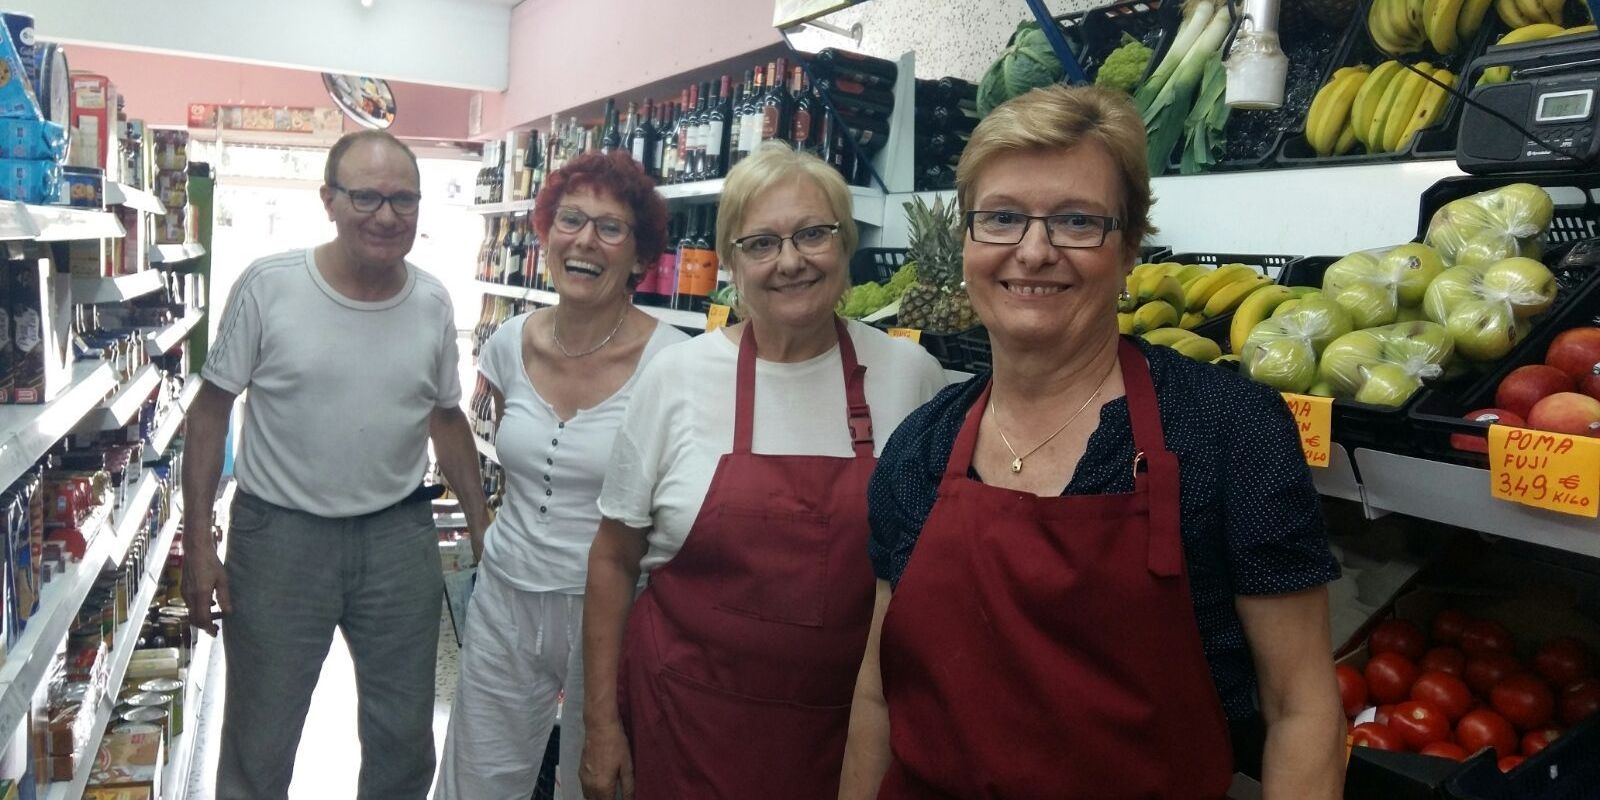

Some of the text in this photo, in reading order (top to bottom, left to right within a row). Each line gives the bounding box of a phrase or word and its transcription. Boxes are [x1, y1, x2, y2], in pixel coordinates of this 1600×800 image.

[1306, 436, 1320, 447] €
[1504, 430, 1574, 454] POMA
[1504, 454, 1548, 469] FUJI
[1558, 475, 1580, 489] €
[1552, 491, 1589, 506] KILO
